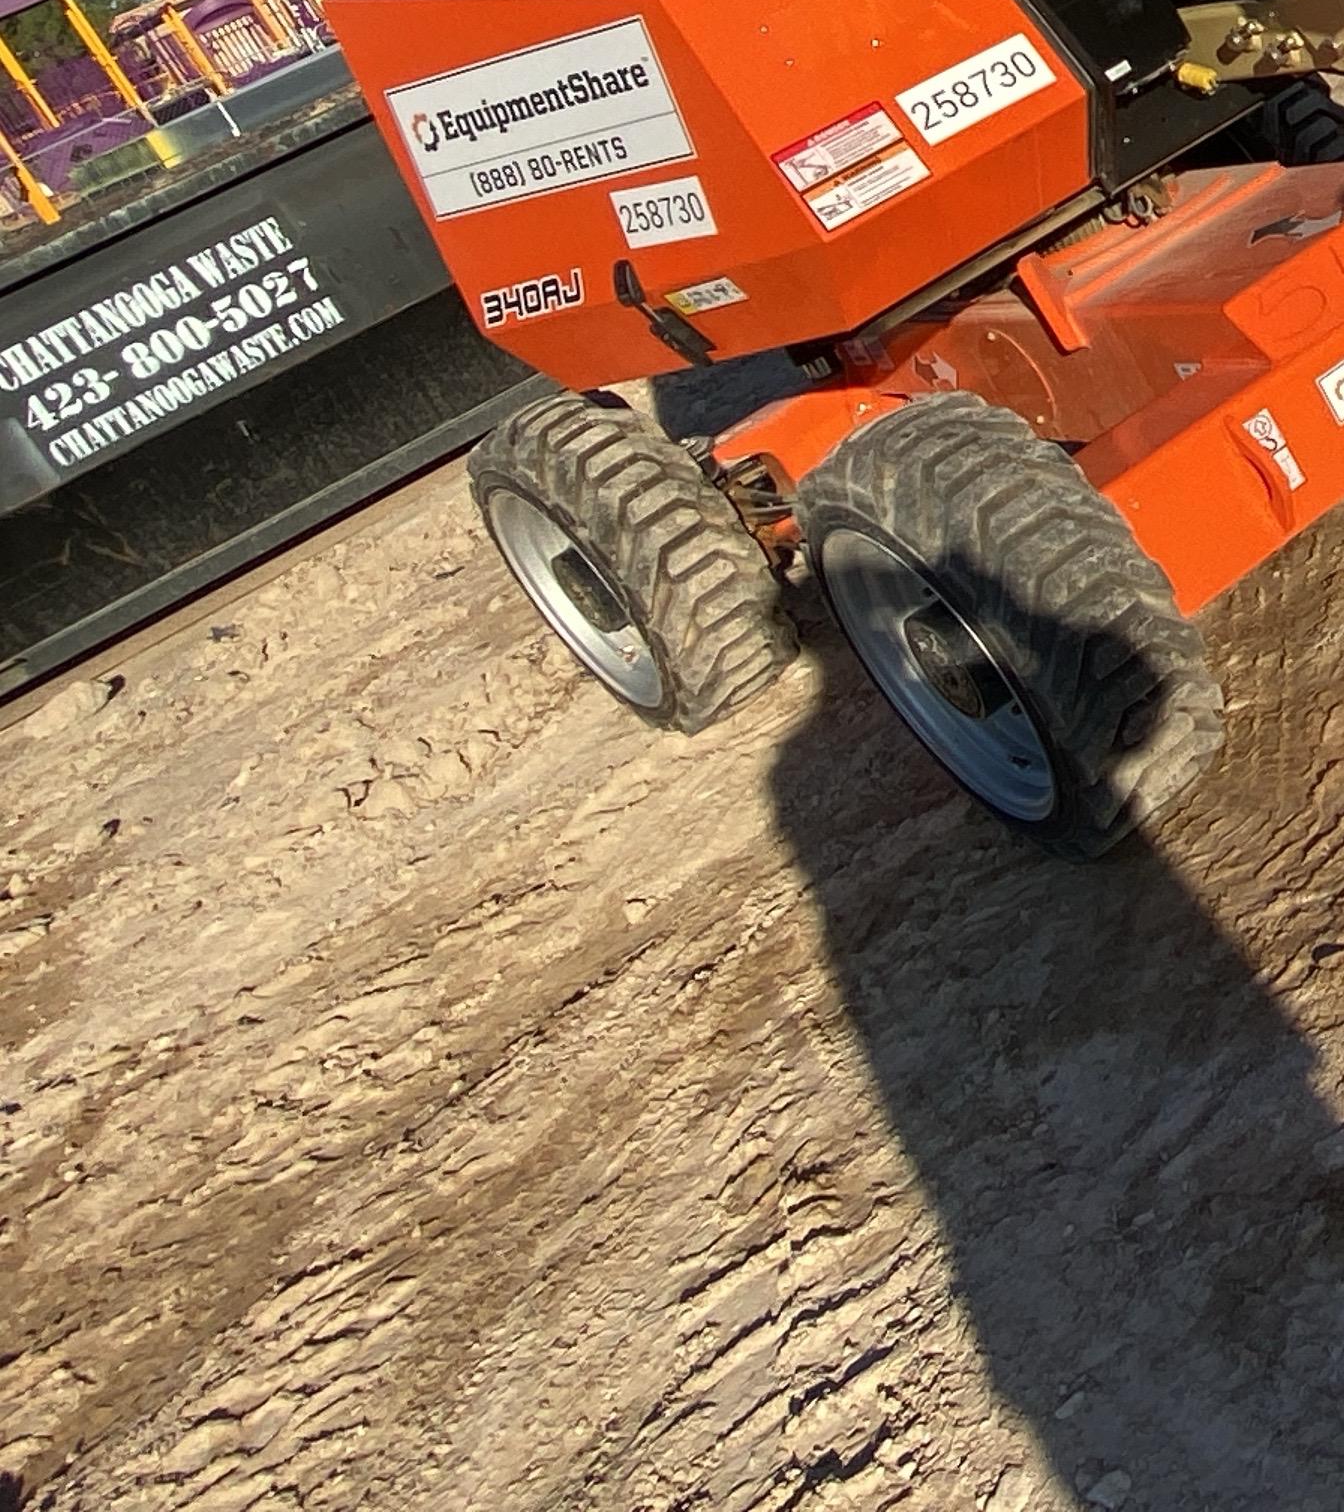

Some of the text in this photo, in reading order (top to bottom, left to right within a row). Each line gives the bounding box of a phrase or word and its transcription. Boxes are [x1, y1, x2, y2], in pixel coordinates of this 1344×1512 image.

[436, 62, 650, 143] EquipmentShare
[910, 51, 1037, 131] 258730
[469, 136, 628, 198] (888) 80-RENTS
[619, 192, 706, 234] 258730
[0, 216, 295, 392] CHATTANOOGA WASTE
[482, 269, 584, 326] 340AJ
[25, 256, 320, 432] 423- 800-5027
[48, 296, 346, 467] CHATTANOOGAWASTE.COM
